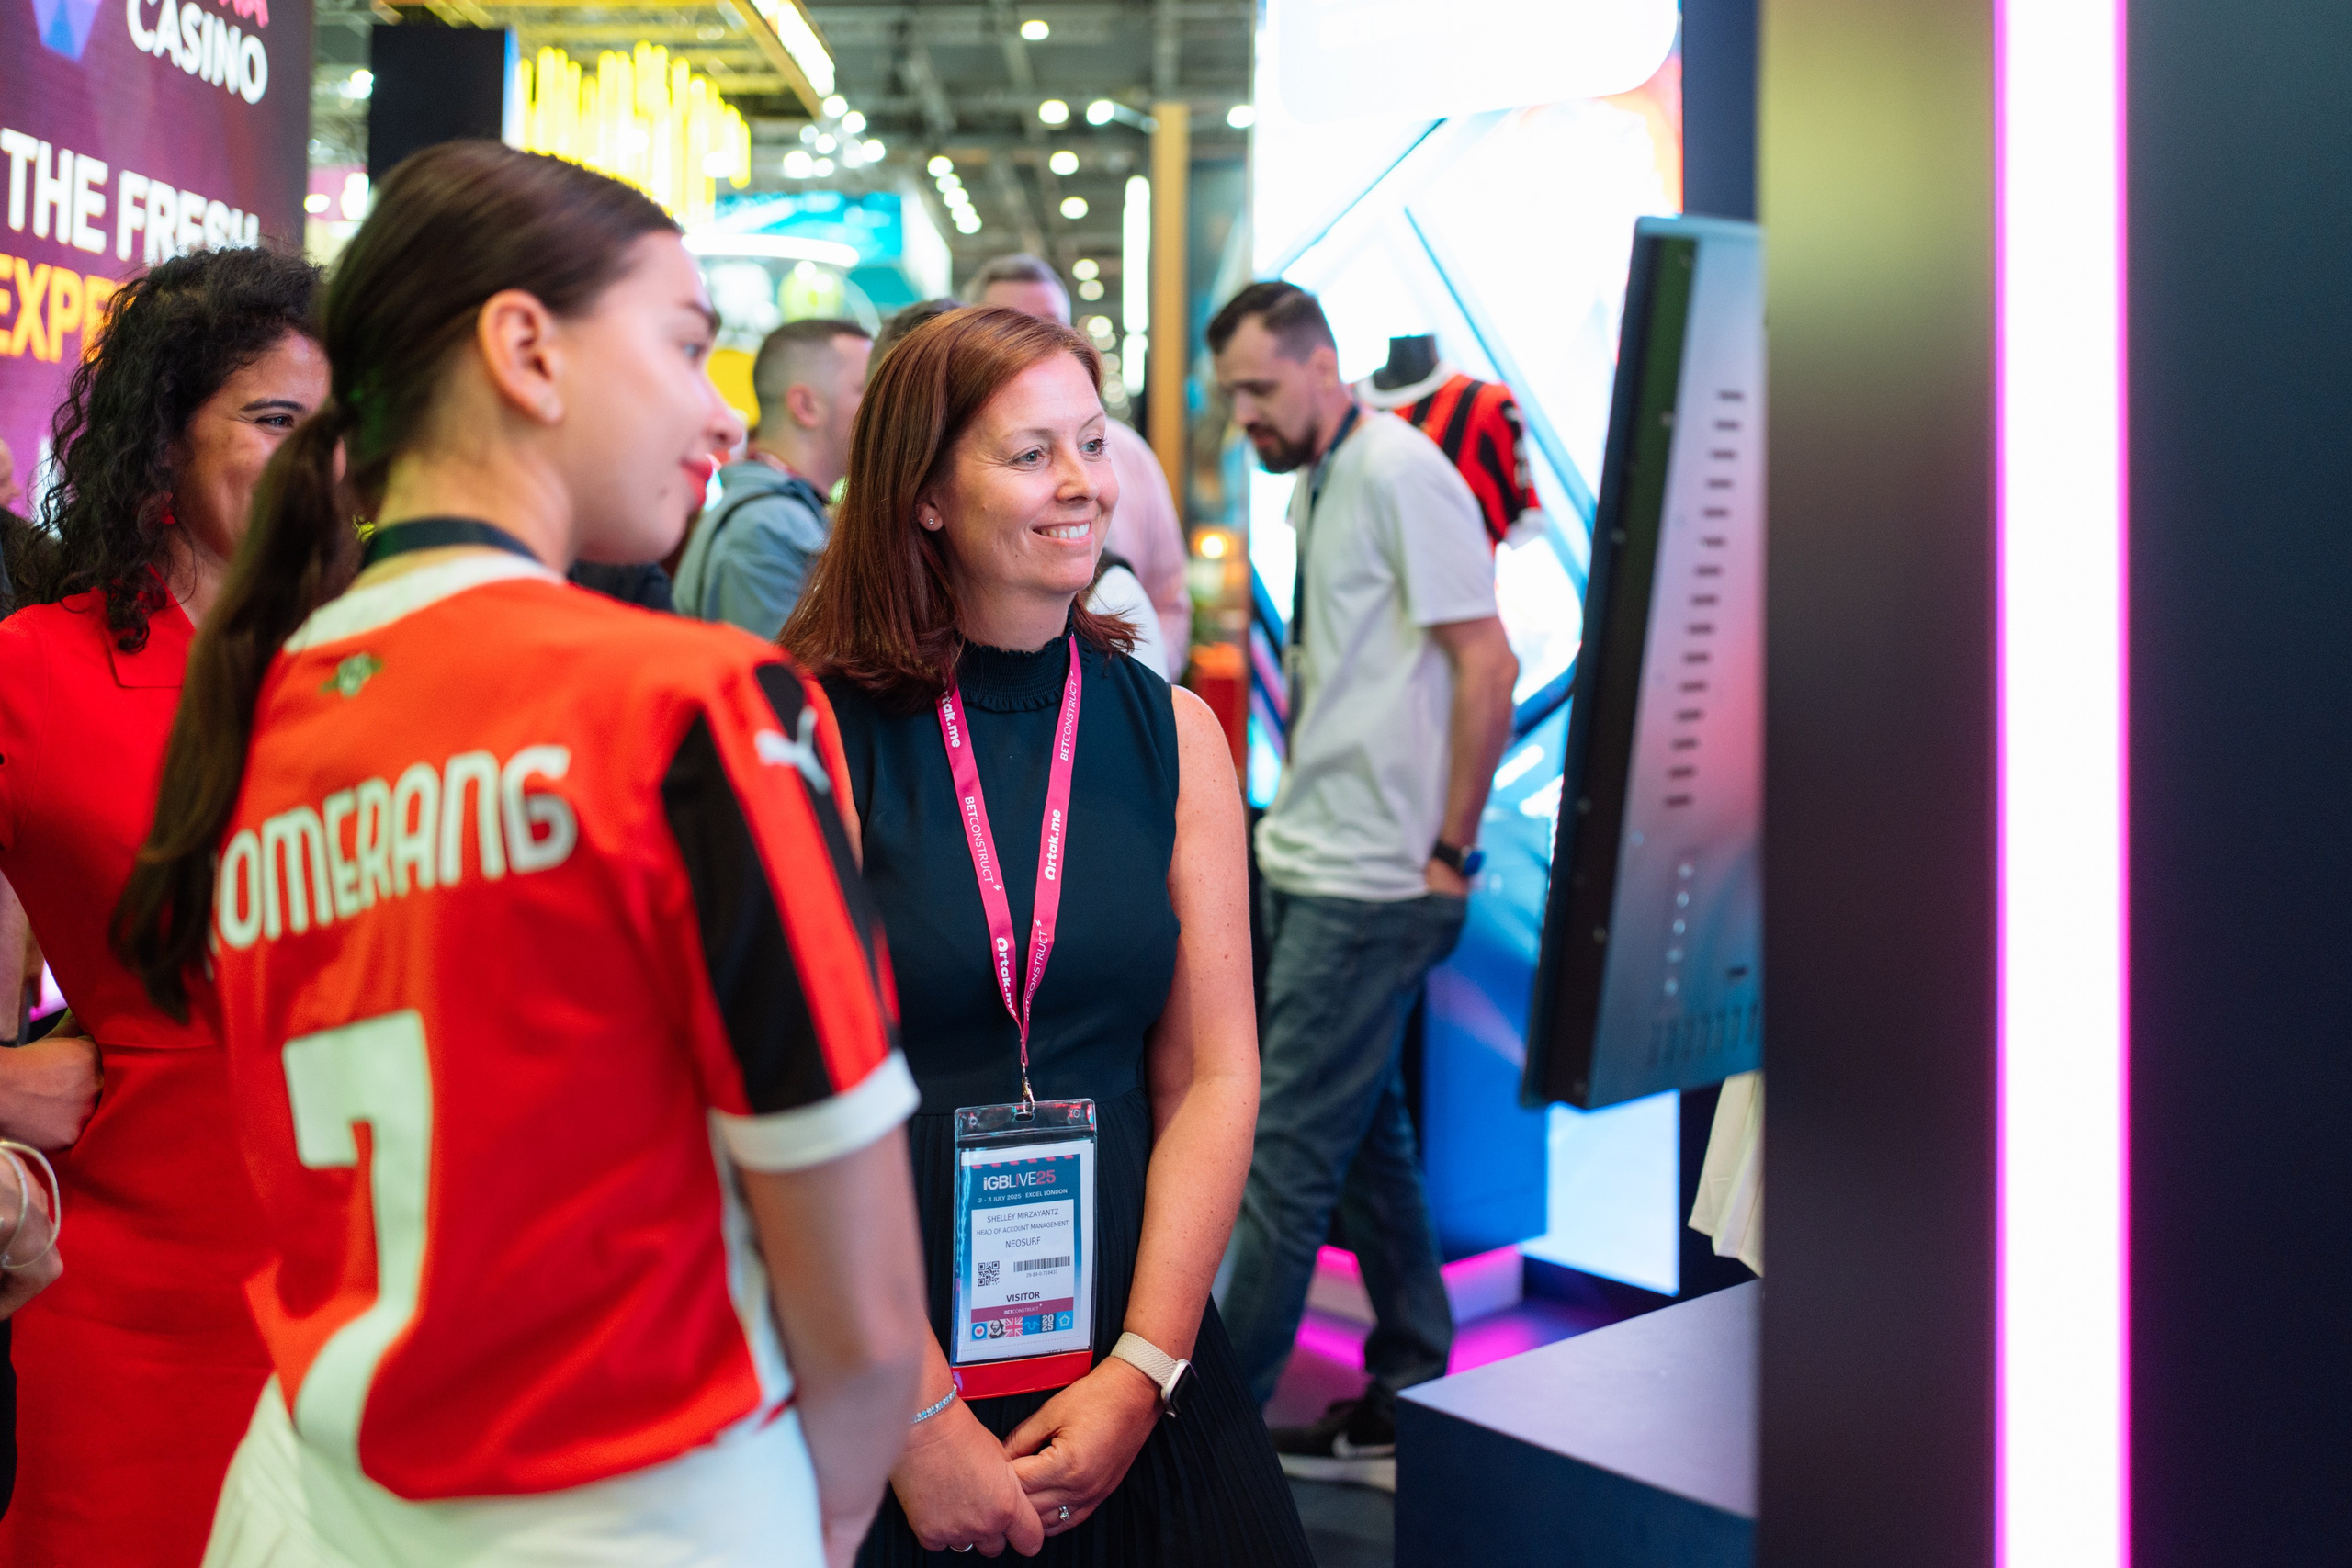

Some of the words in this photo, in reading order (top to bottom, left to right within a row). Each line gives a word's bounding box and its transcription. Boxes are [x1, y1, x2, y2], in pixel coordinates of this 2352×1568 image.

[126, 0, 269, 105] CASINO
[0, 127, 108, 255] THE
[942, 678, 961, 749] tak.me
[1059, 679, 1078, 761] BETCONSTRUCT
[964, 795, 994, 884] BETCONSTRUCT
[208, 745, 578, 950] OMERANG
[1044, 1188, 1068, 1197] LONDON
[987, 1214, 1015, 1223] SHELLEY
[1017, 1208, 1059, 1220] MIRZAYANTZ
[1002, 1224, 1030, 1234] ACCOUNT
[1030, 1219, 1069, 1231] MANAGEMENT
[281, 1008, 433, 1476] 7
[1005, 1236, 1041, 1248] NEOSURF
[1006, 1291, 1040, 1303] VISITOR
[1003, 1306, 1039, 1315] BETCONSTRUCT
[1042, 1314, 1055, 1323] 20
[1042, 1323, 1054, 1332] 25
